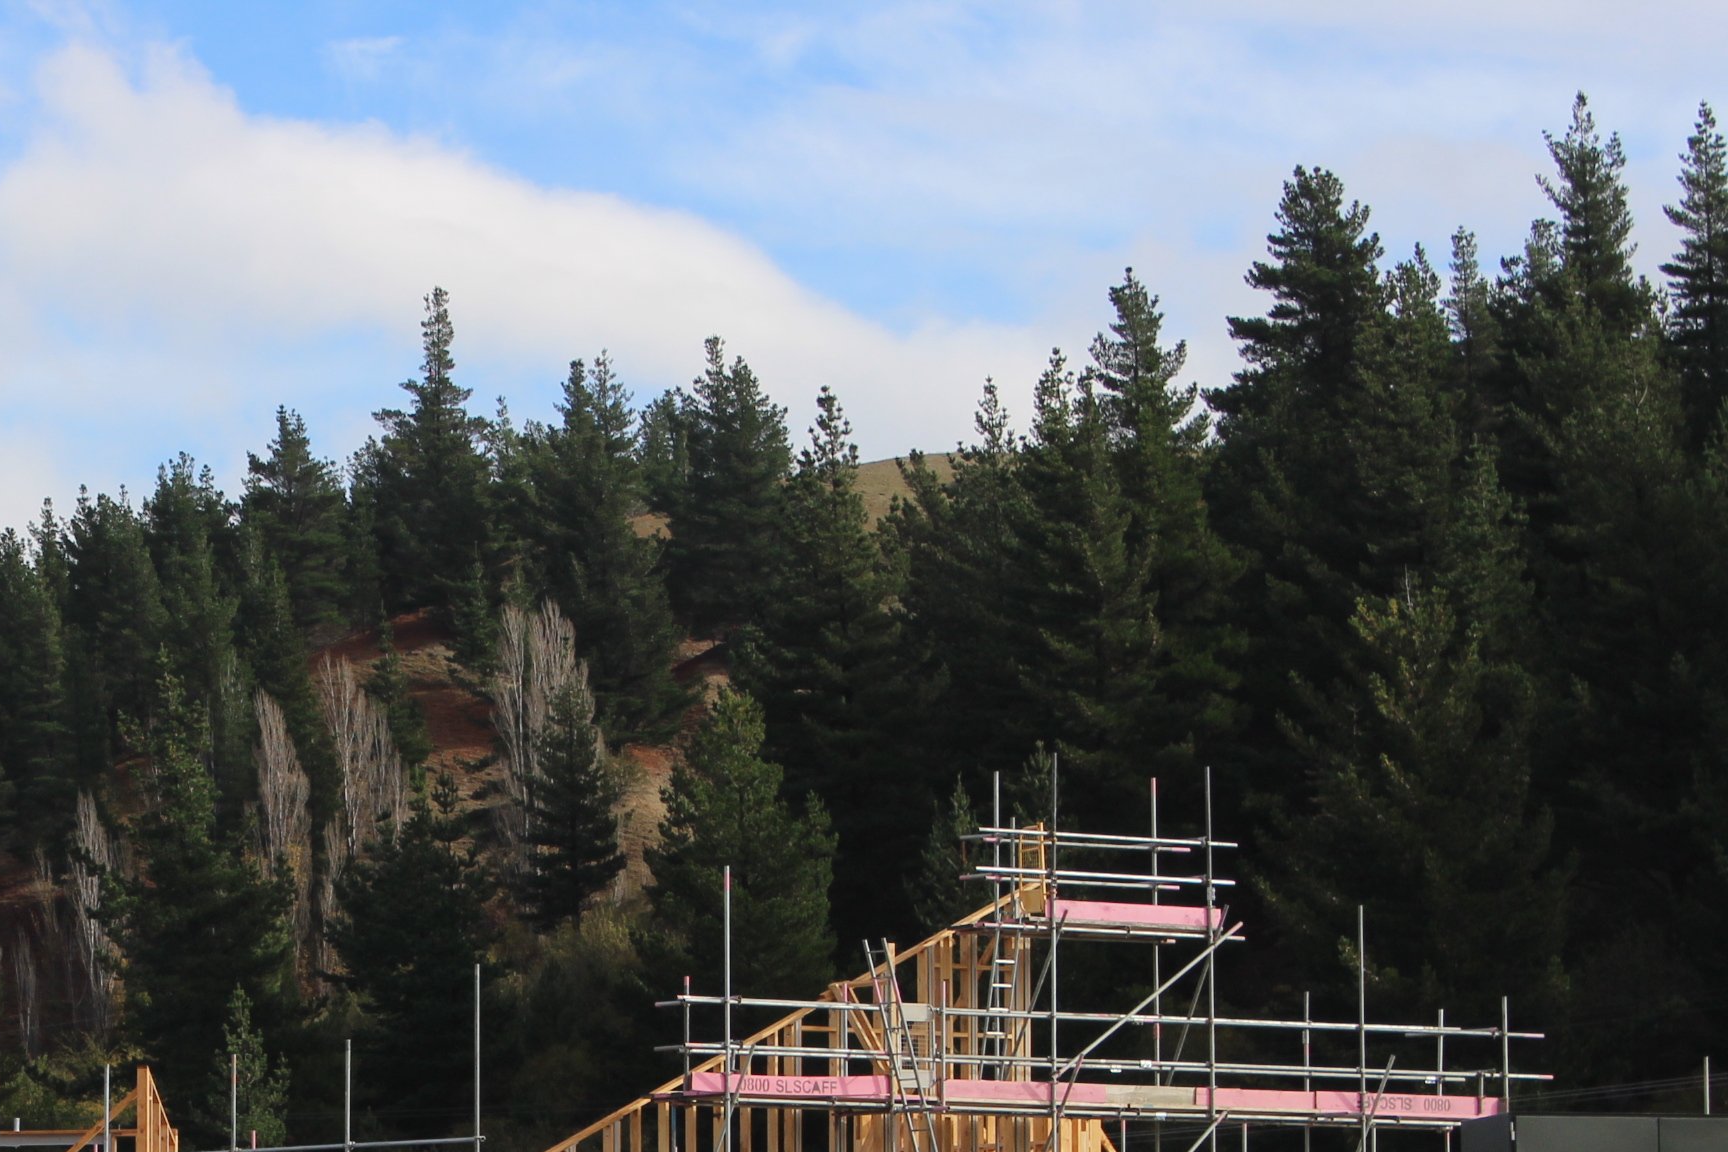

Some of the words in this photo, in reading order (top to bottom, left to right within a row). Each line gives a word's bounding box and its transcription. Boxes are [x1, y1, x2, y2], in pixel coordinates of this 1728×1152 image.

[739, 1078, 770, 1091] 0800
[776, 1080, 837, 1093] SLSCAFF
[1423, 1098, 1451, 1112] 0800
